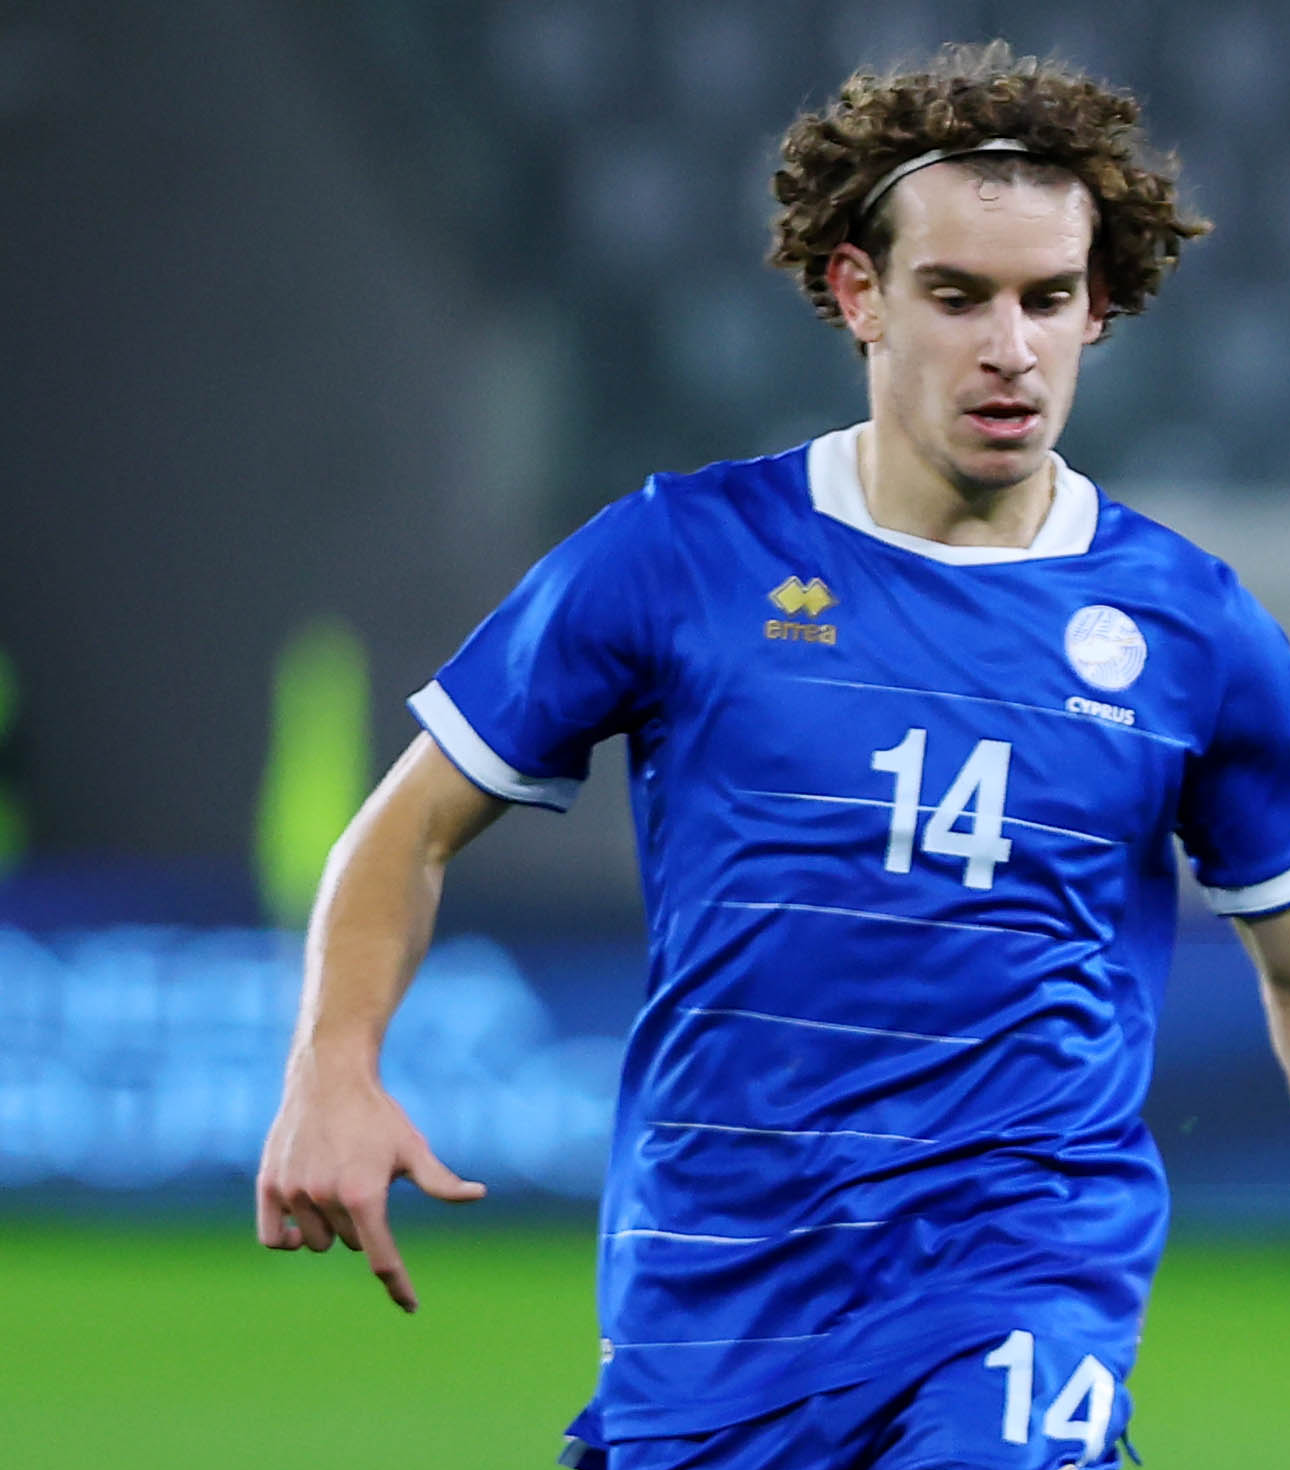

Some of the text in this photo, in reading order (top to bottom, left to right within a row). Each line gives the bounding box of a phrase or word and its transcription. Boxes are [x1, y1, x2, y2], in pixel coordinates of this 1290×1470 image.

[1065, 696, 1136, 727] CYPRUS
[872, 728, 1013, 890] 14
[985, 1329, 1116, 1467] 14
